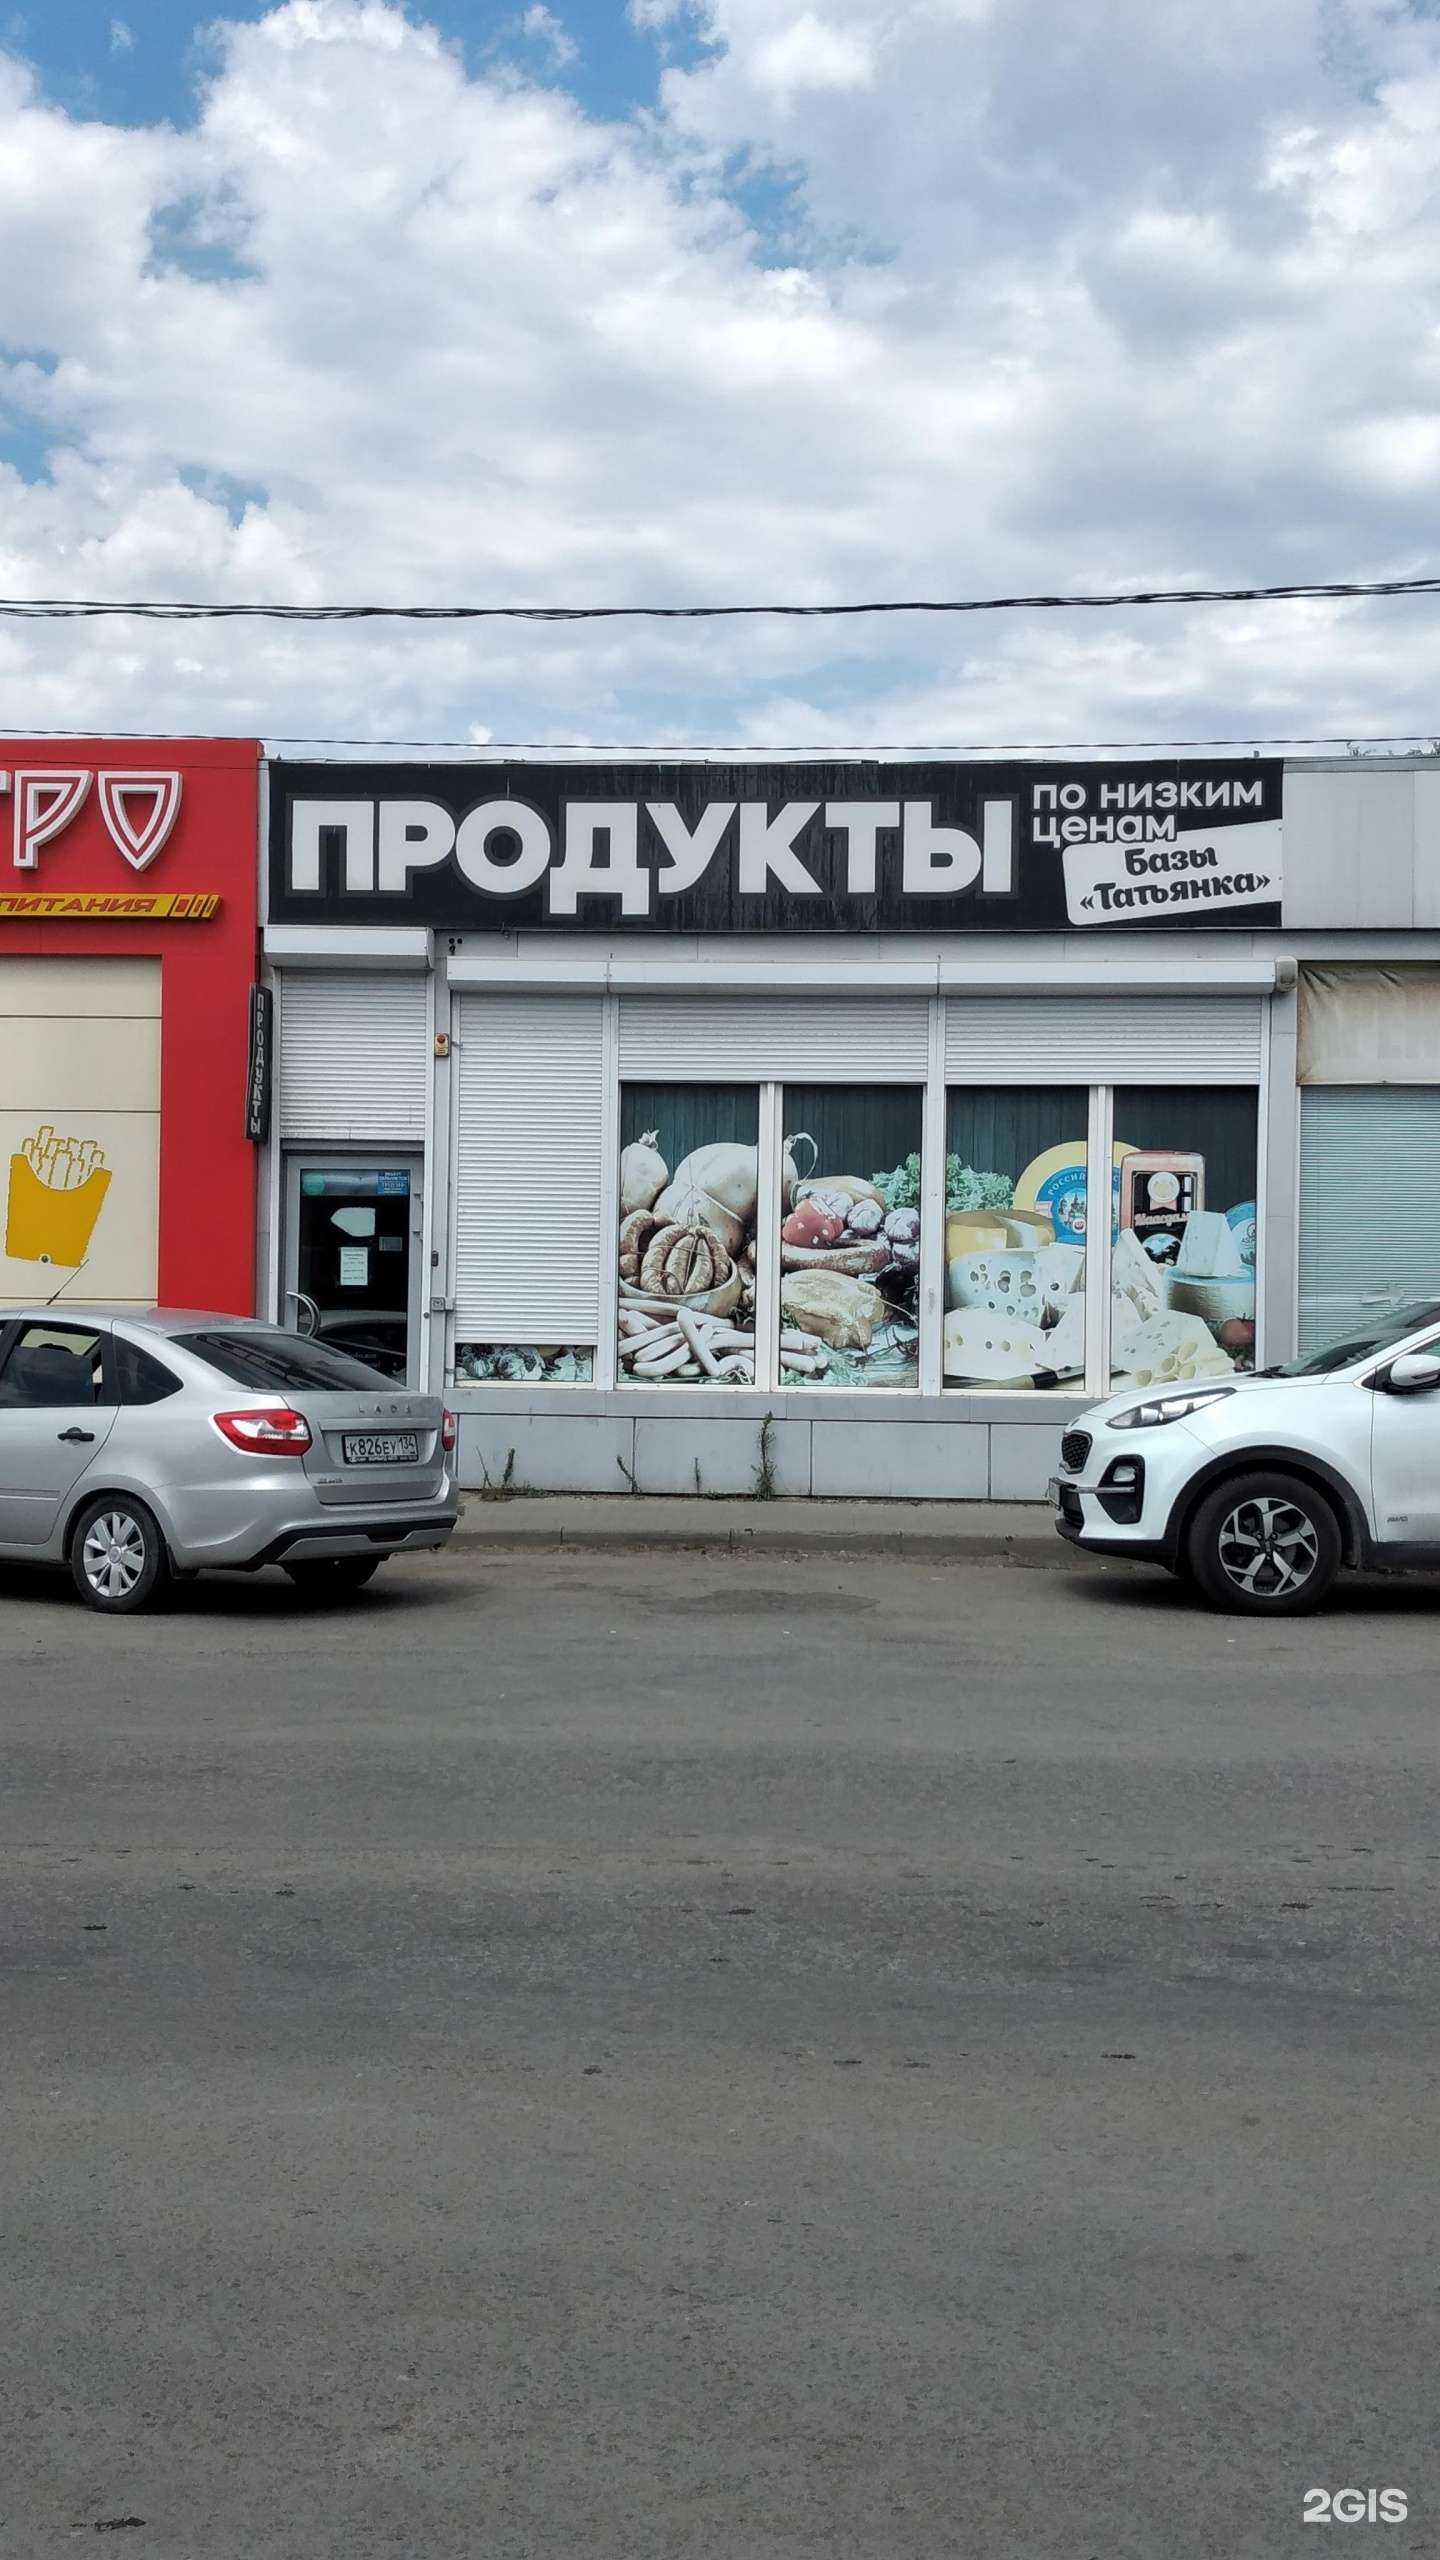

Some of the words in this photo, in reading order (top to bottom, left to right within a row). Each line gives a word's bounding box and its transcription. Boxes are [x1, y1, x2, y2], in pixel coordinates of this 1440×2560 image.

[0, 770, 183, 871] РО
[1032, 814, 1175, 848] ценам
[292, 800, 1012, 914] ПРОДУКТЫ
[1079, 872, 1271, 910] «Татьянка»
[250, 993, 265, 1134] ПРОДУКТЫ
[350, 1438, 397, 1456] К826ЕУ
[399, 1436, 415, 1450] 134
